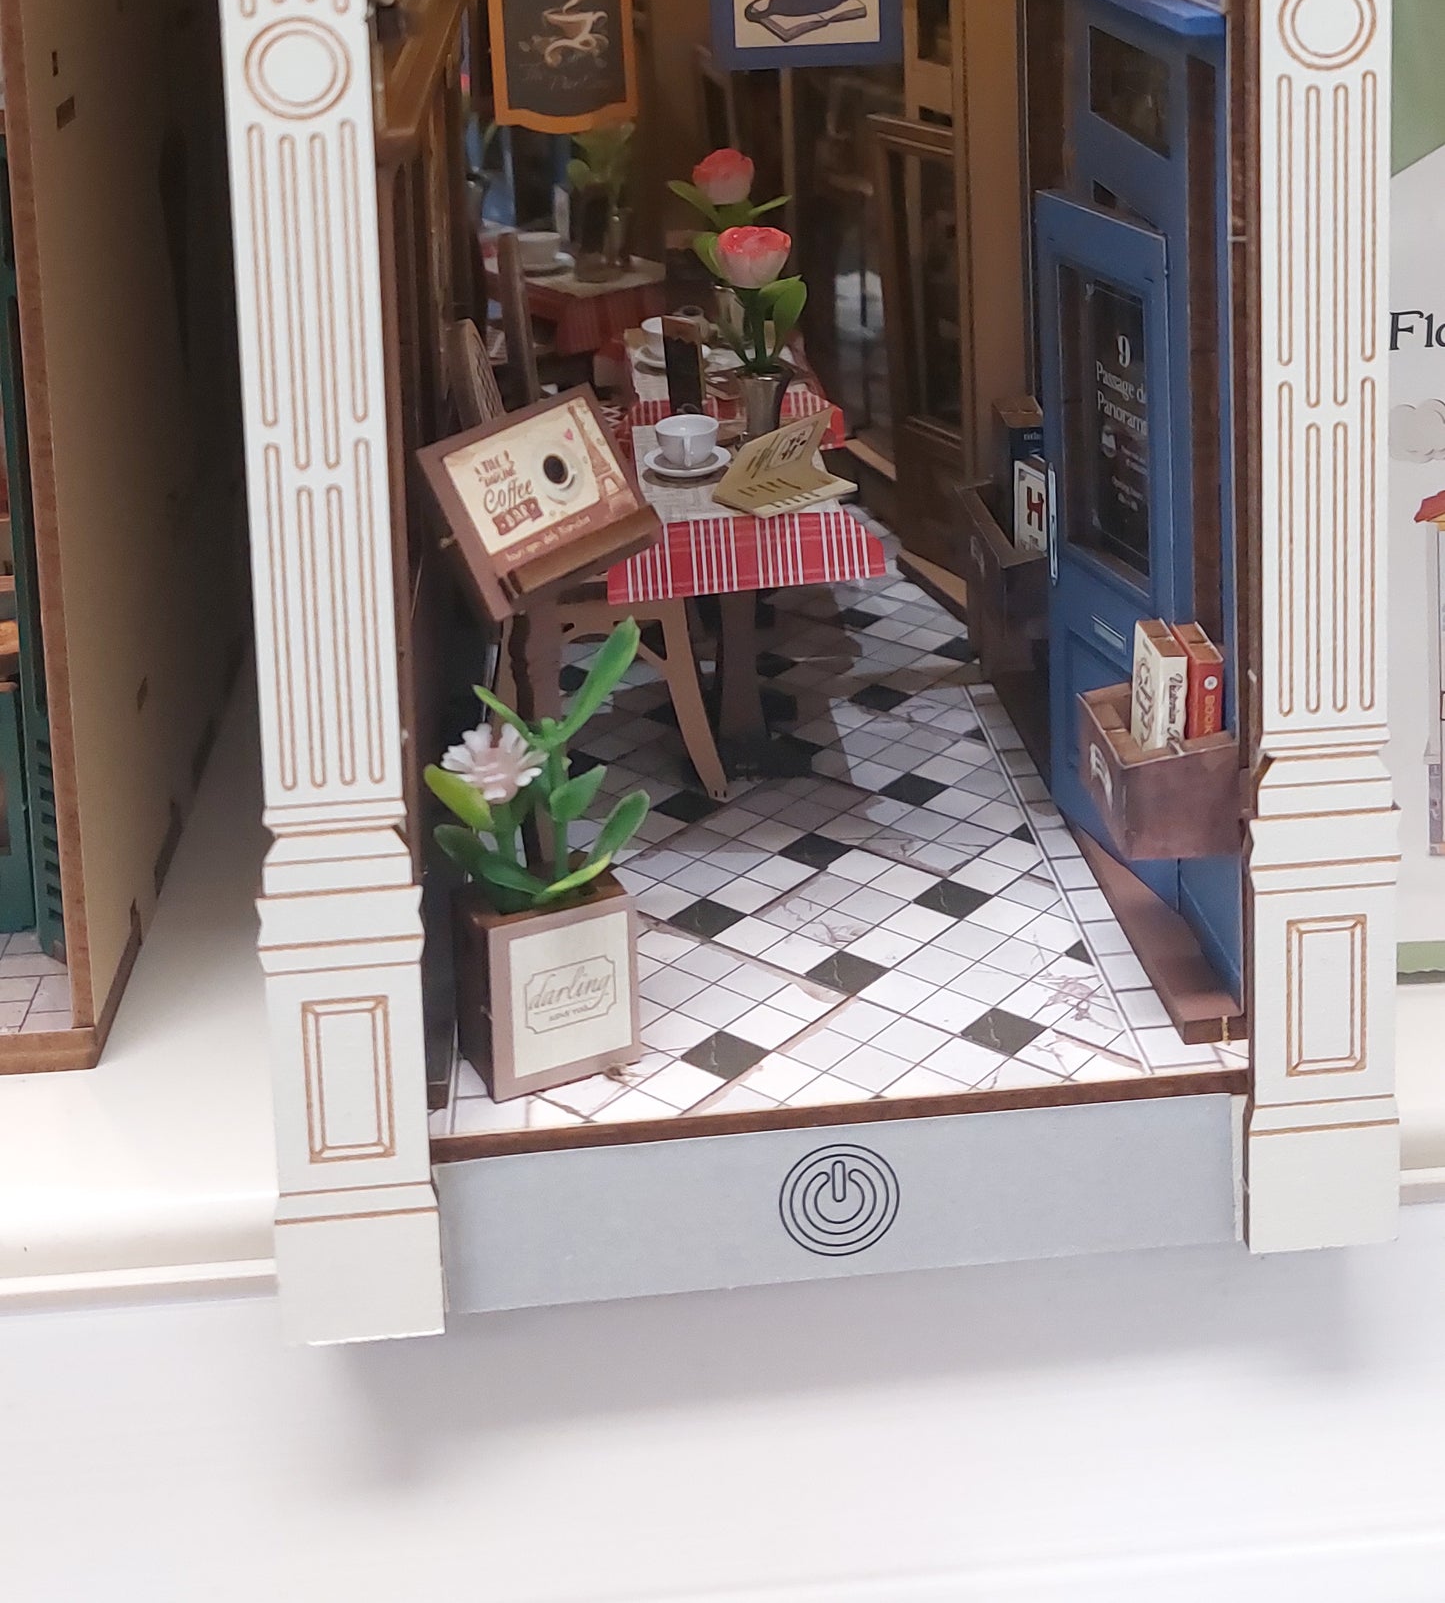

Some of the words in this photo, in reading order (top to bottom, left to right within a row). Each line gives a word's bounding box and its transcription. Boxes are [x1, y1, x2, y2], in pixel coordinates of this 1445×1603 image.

[1116, 334, 1132, 369] 9
[1095, 360, 1136, 402] Passage
[484, 478, 534, 514] Coffee
[528, 966, 614, 1011] darling
